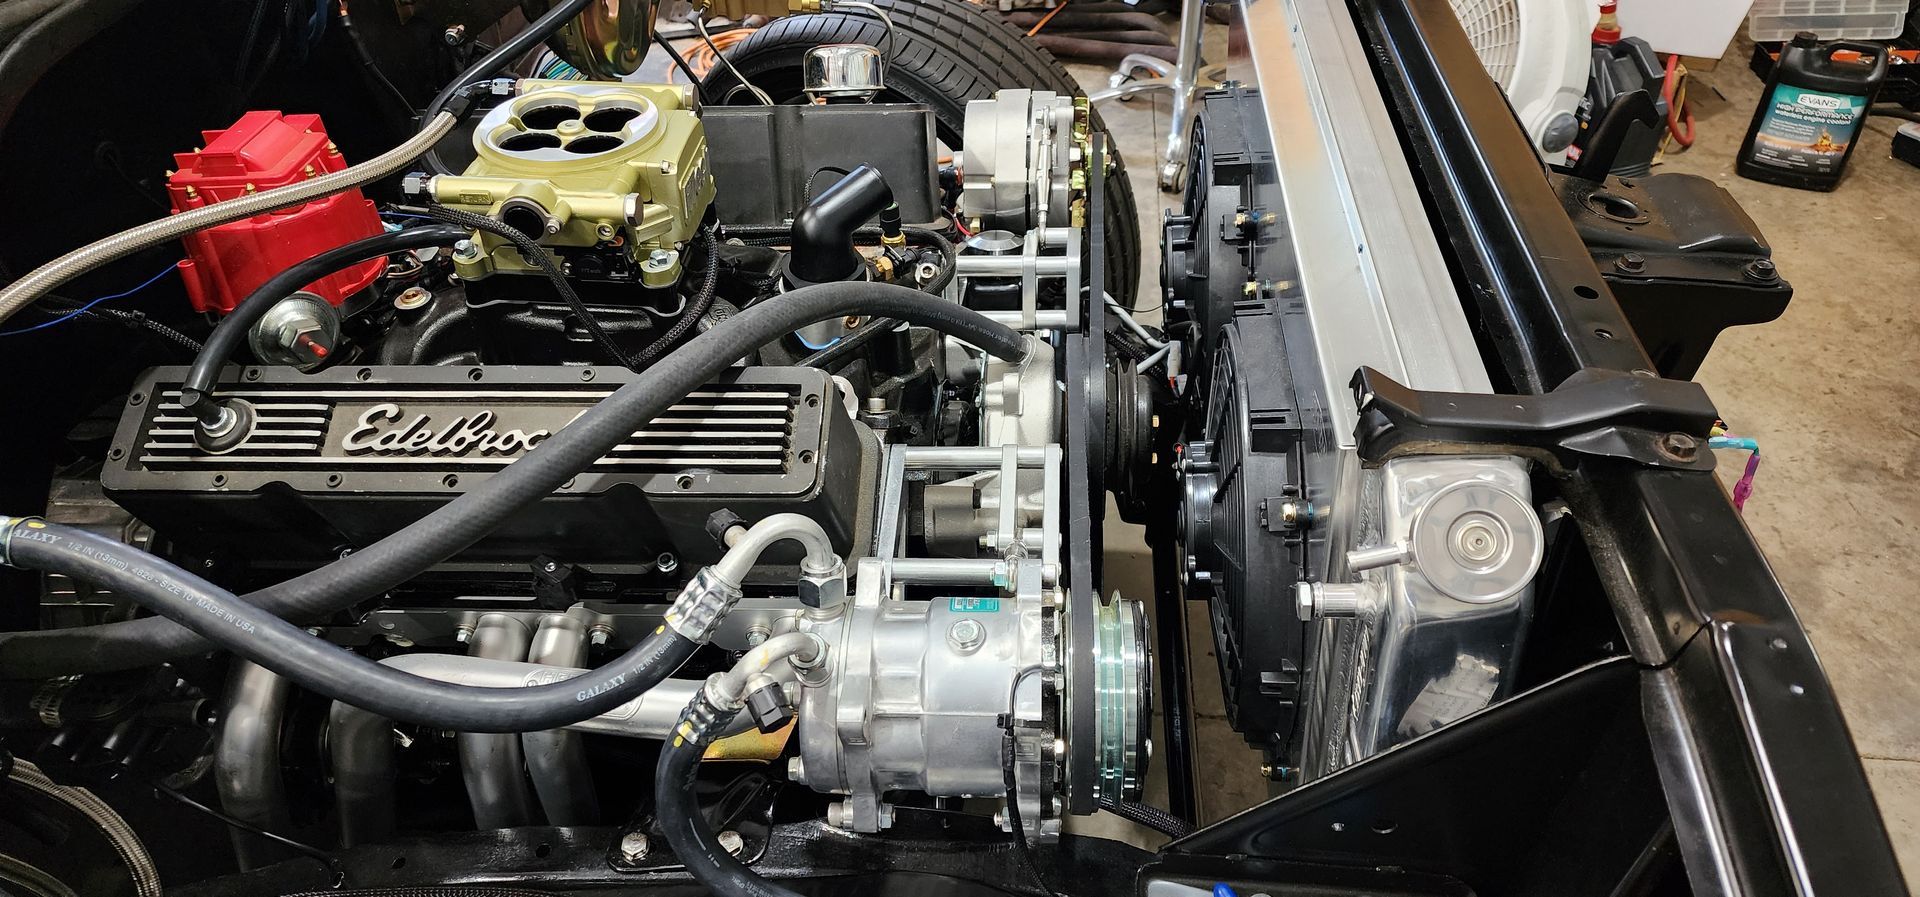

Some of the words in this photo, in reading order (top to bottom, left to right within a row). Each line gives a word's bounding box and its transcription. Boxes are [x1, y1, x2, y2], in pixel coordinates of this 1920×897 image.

[1800, 96, 1838, 108] EVANS
[341, 403, 587, 453] Edelbroc
[12, 528, 62, 545] ALAXY
[67, 541, 82, 552] 1/2
[82, 545, 96, 556] IN
[159, 579, 183, 596] SIZE
[195, 597, 224, 618] MADE
[222, 611, 236, 624] IN
[235, 618, 256, 635] USA
[576, 672, 628, 702] GALAXY
[632, 662, 647, 676] 1/2
